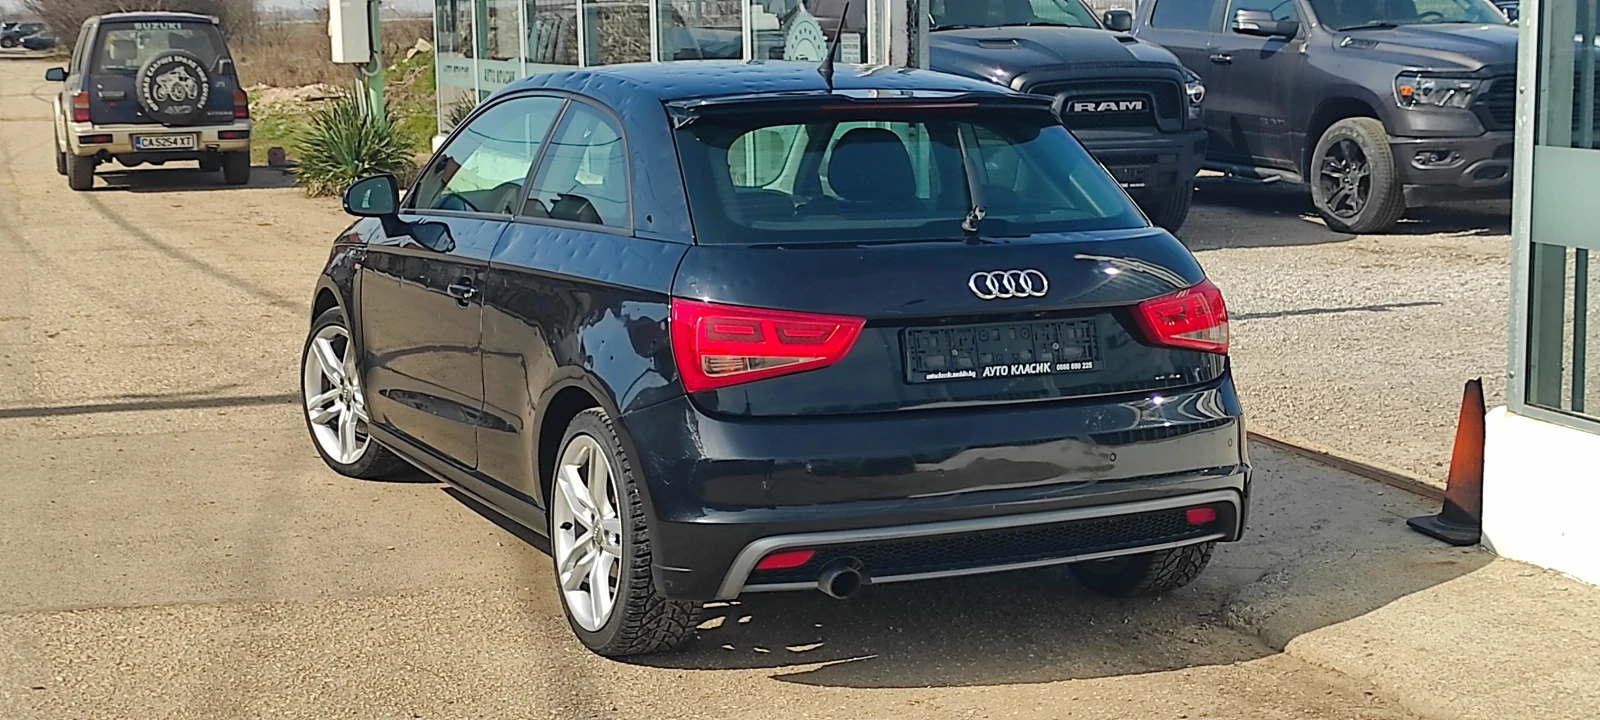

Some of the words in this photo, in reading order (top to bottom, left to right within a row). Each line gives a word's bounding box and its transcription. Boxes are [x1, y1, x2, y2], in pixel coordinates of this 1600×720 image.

[134, 22, 182, 30] SUZUKI
[1073, 100, 1143, 112] RAM
[982, 365, 1008, 378] АУТО
[1010, 362, 1051, 376] КЛАСИК
[1082, 361, 1093, 369] 225
